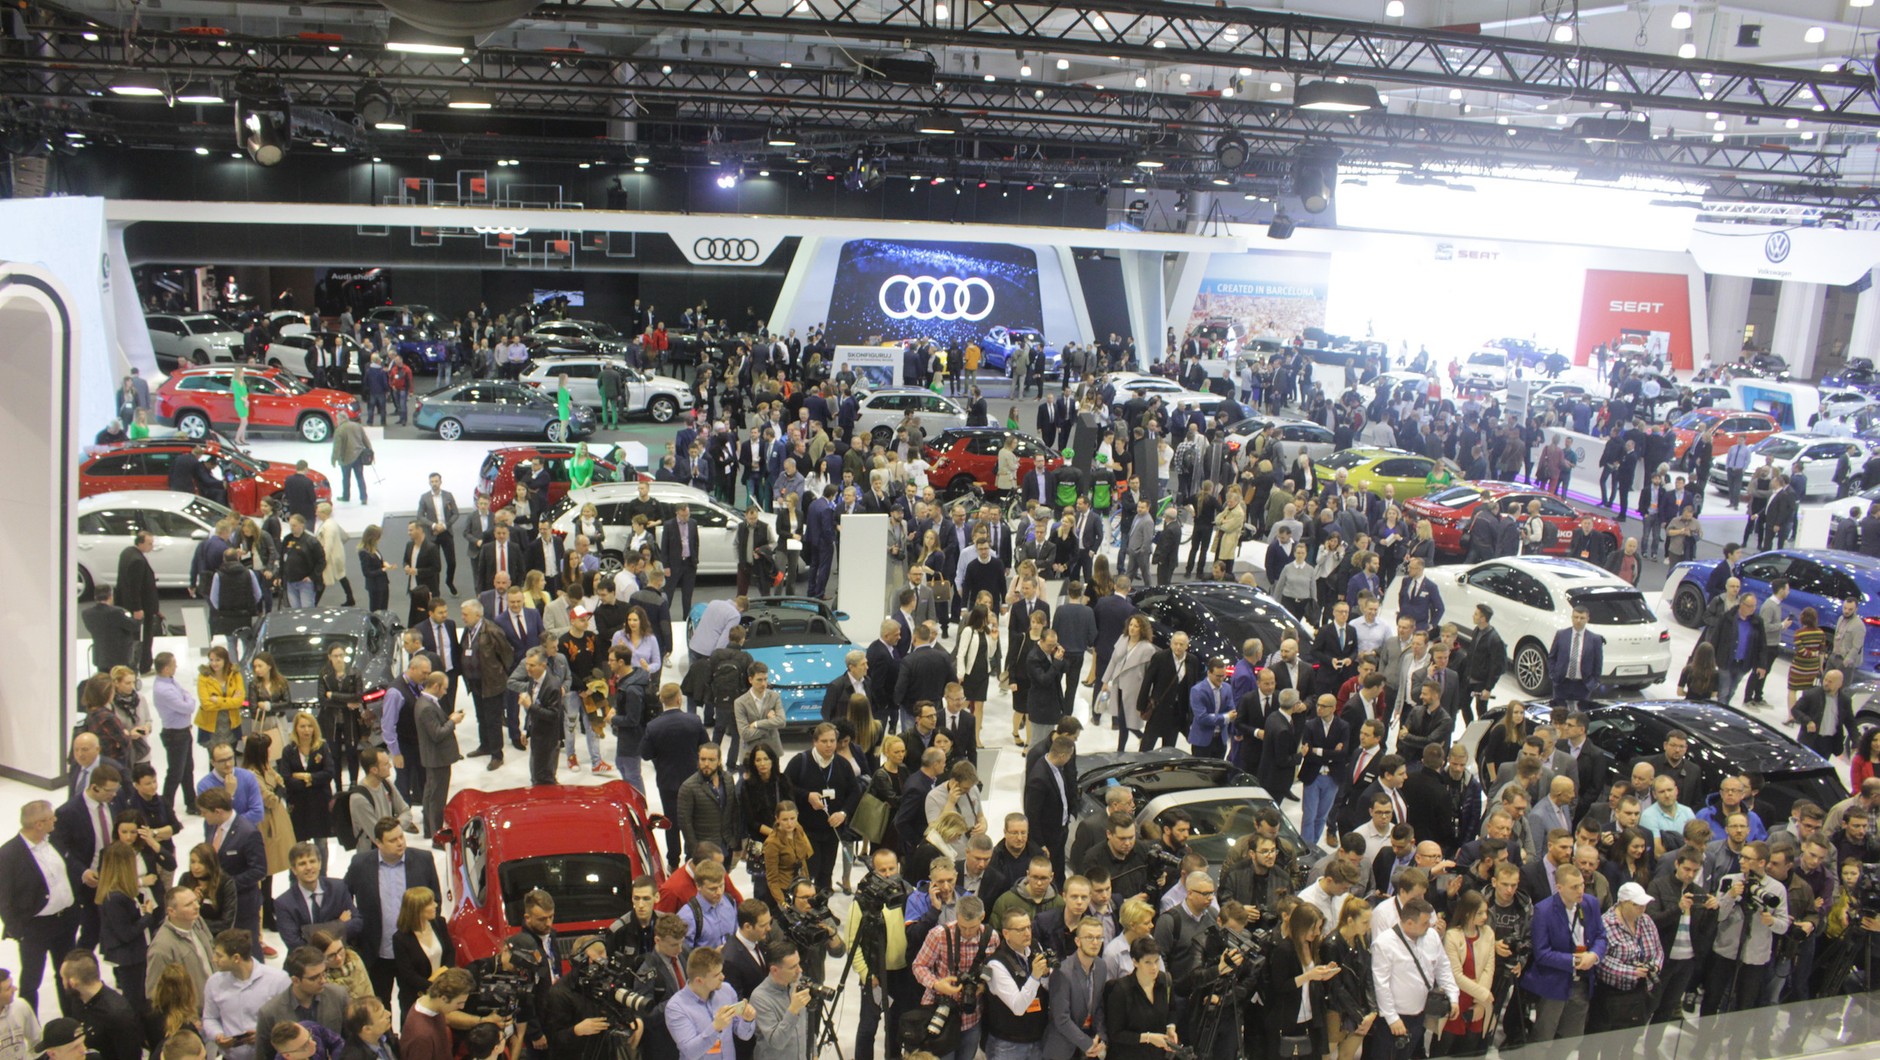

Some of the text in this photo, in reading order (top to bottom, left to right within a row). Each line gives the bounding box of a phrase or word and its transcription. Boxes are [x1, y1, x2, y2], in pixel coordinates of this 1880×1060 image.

[1458, 250, 1500, 260] SEAT
[331, 272, 351, 280] Audi
[1217, 283, 1314, 297] CREATED IN BARCELONA
[1609, 300, 1664, 314] SEAT
